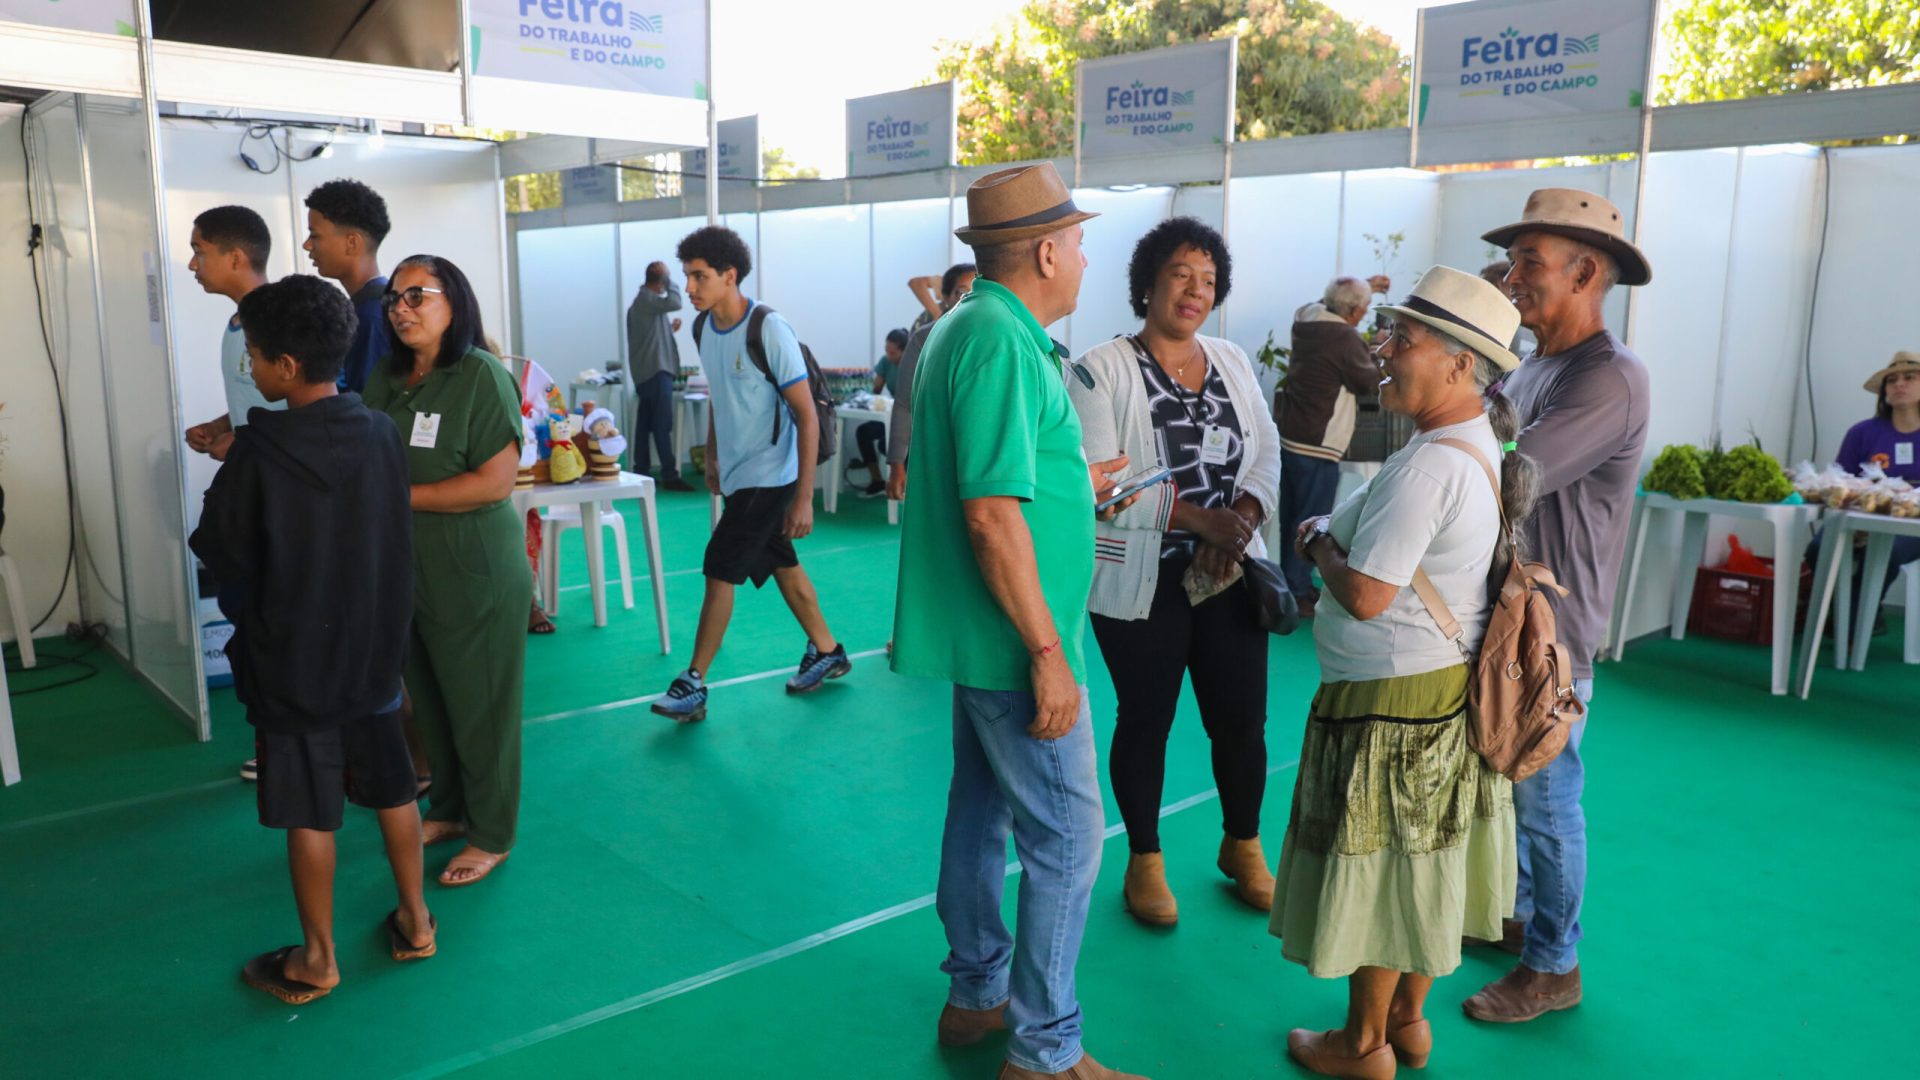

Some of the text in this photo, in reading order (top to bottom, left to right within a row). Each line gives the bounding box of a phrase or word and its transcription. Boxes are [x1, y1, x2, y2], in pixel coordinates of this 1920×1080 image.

[519, 0, 623, 27] Feira
[520, 24, 632, 49] DO TRABALHO
[1462, 26, 1558, 67] Feira
[571, 48, 665, 70] E DO CAMPO
[1460, 63, 1563, 86] DO TRABALHO
[1503, 74, 1598, 96] E DO CAMPO
[1106, 80, 1168, 110] Feira
[867, 117, 910, 141] Feira
[1105, 111, 1172, 125] DO TRABALHO
[1133, 122, 1194, 135] E DO CAMPO
